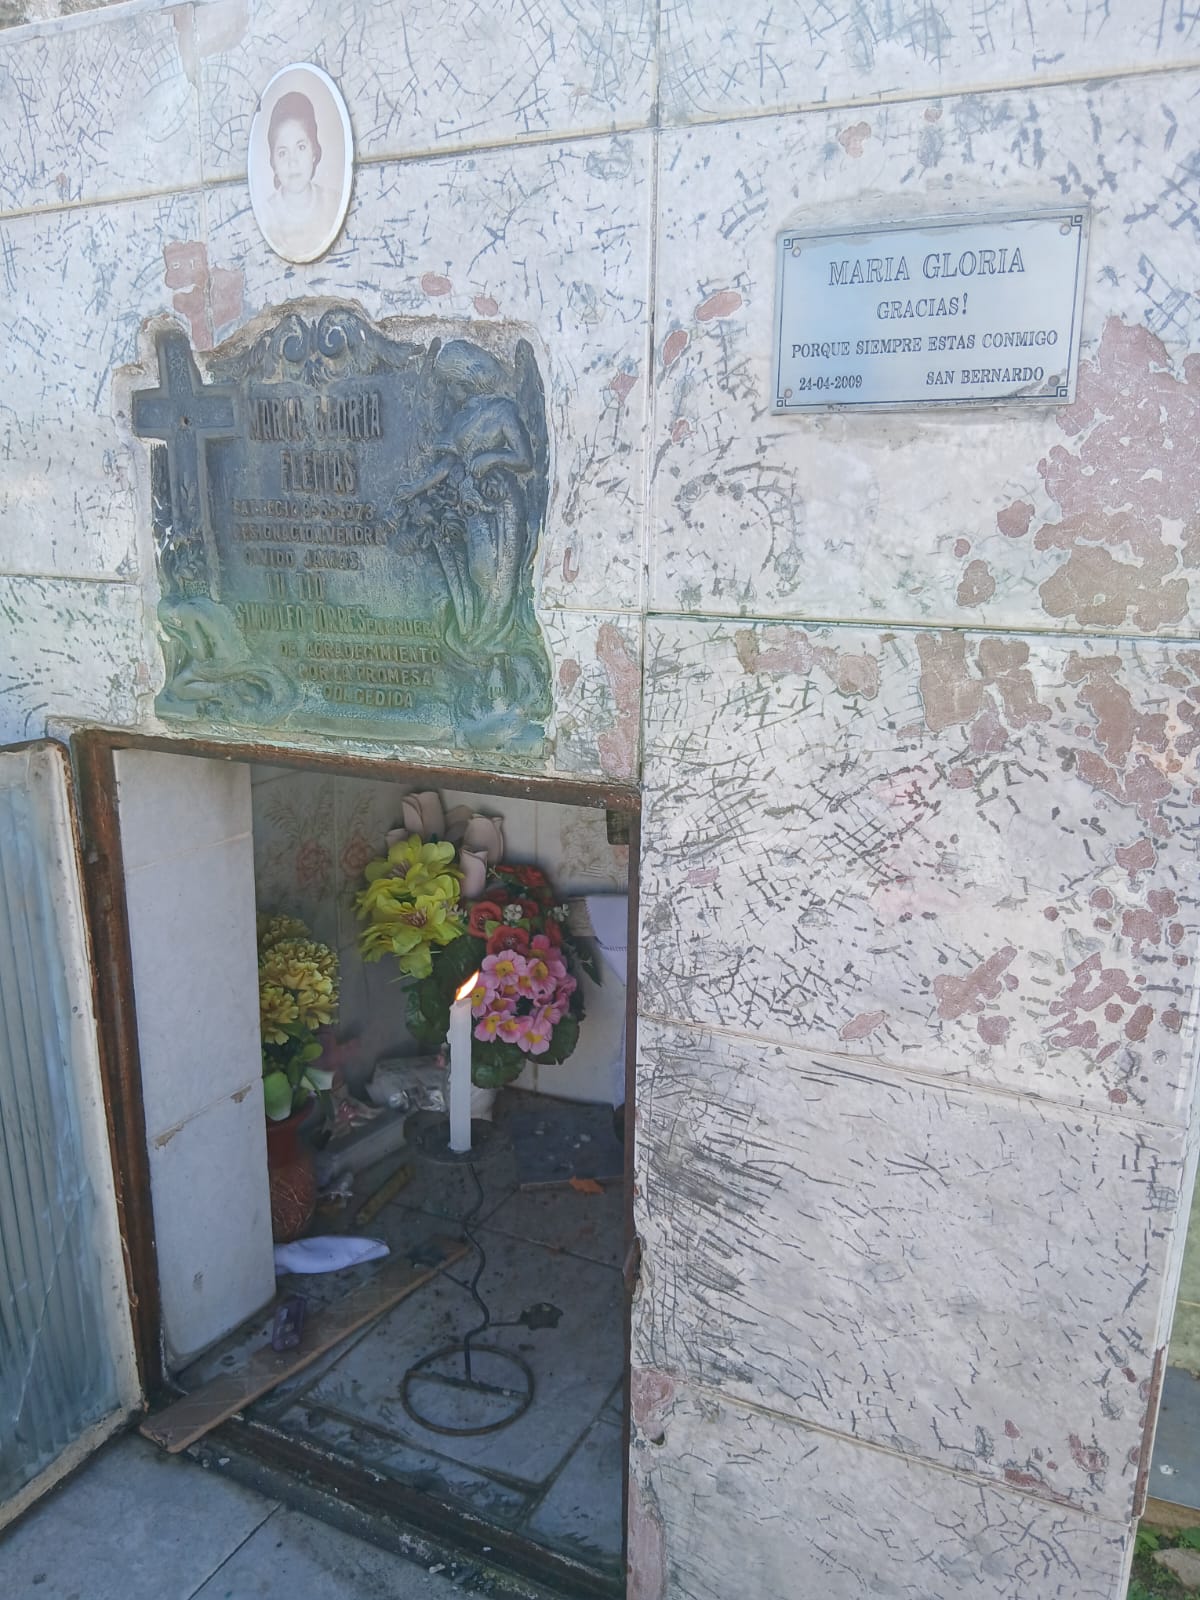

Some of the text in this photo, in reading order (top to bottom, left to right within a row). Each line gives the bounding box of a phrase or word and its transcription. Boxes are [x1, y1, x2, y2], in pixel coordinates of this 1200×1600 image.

[828, 247, 1026, 286] MARIA GLORIA
[876, 292, 968, 320] GRACIAS!
[791, 330, 1058, 359] PORQUE SIEMPRE ESTAS CONMIGO
[799, 366, 1045, 391] 24-04-2009 SAN BERNARDO
[250, 391, 383, 441] MARIA GLORIA
[313, 603, 370, 635] TORRES
[300, 664, 433, 687] POR LA PROMESA
